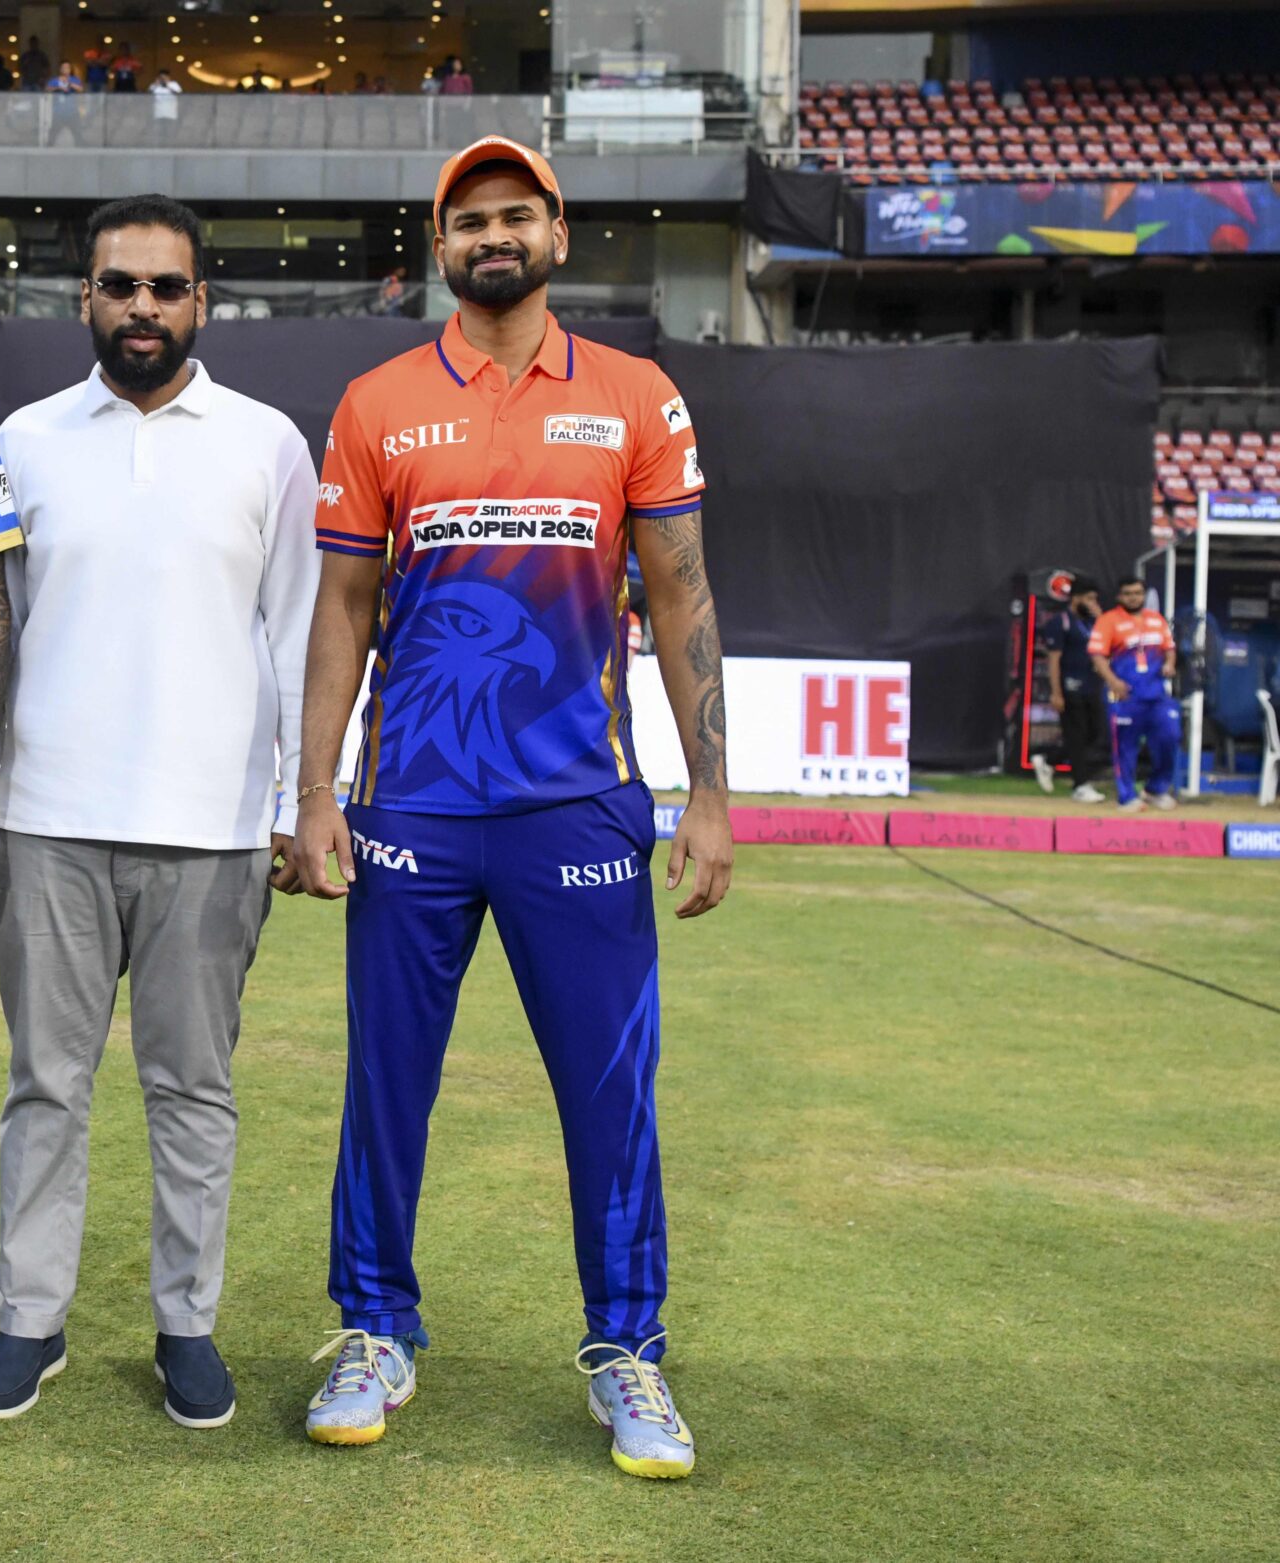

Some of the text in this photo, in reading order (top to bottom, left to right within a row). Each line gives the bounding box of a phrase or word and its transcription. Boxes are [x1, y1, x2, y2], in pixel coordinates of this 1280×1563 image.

[550, 431, 610, 444] FALCONS
[468, 520, 537, 538] OPEN
[541, 521, 594, 541] 2026
[802, 768, 906, 782] ENERGY
[352, 829, 419, 874] TYKA
